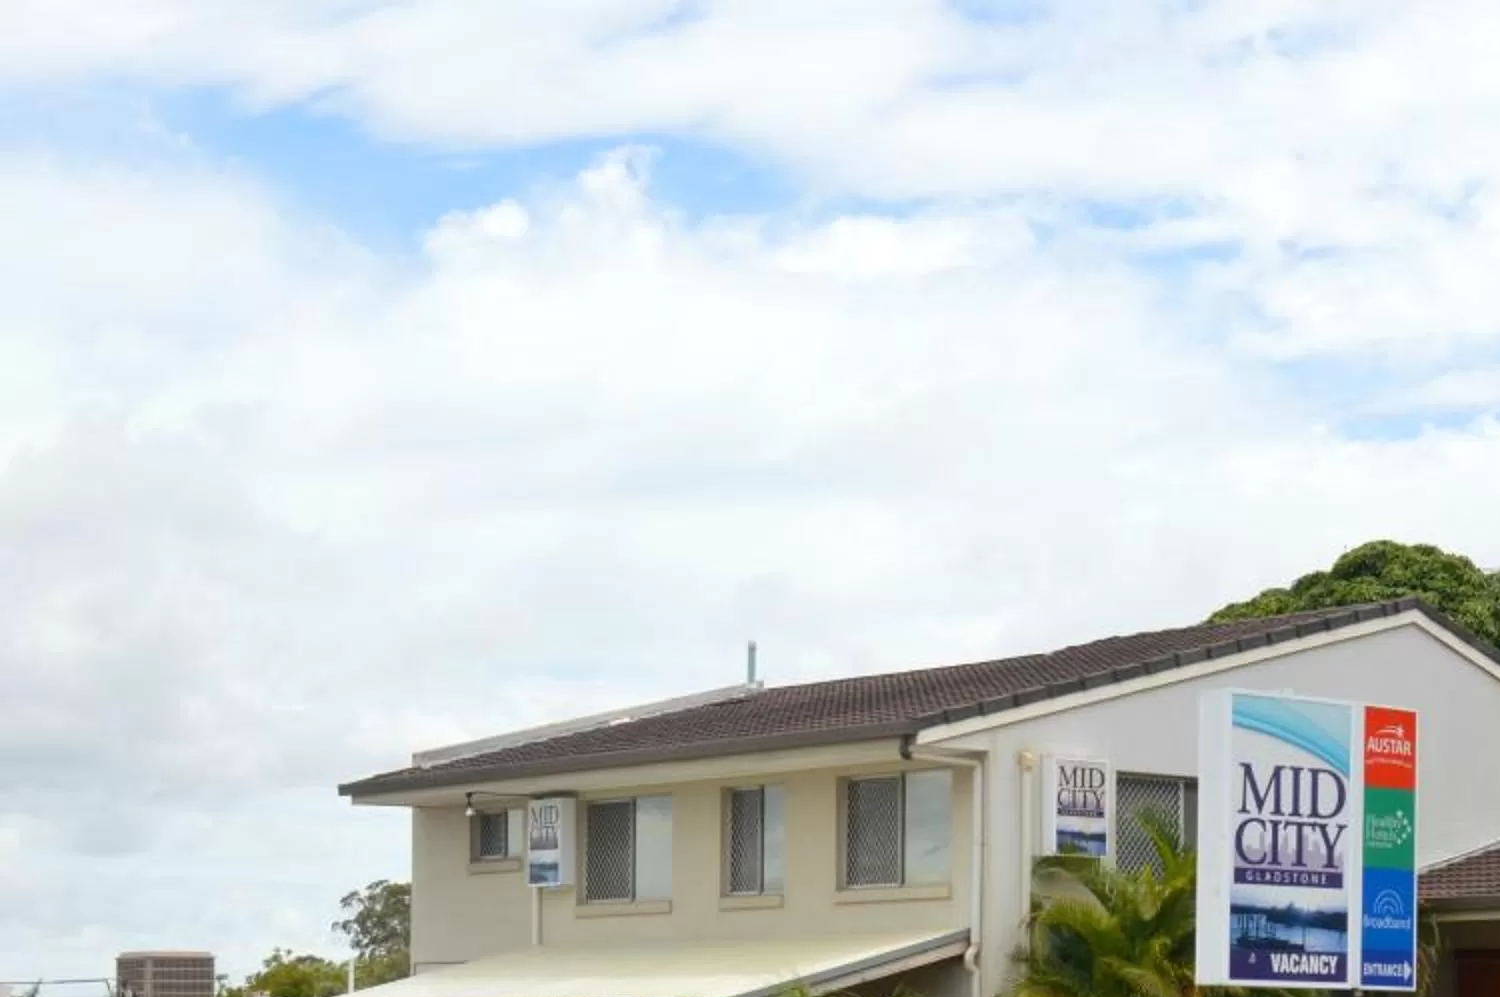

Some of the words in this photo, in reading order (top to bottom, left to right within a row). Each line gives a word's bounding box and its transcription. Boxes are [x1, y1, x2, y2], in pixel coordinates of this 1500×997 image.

[1367, 736, 1412, 756] AUSTAR
[1059, 765, 1105, 789] MID
[1058, 788, 1105, 809] CITY
[1238, 762, 1346, 819] MID
[531, 805, 559, 825] MID
[1235, 817, 1348, 869] CITY
[1245, 869, 1329, 885] GLADSTONE
[1269, 952, 1338, 976] VACANCY
[1363, 962, 1405, 977] ENTRANCE
